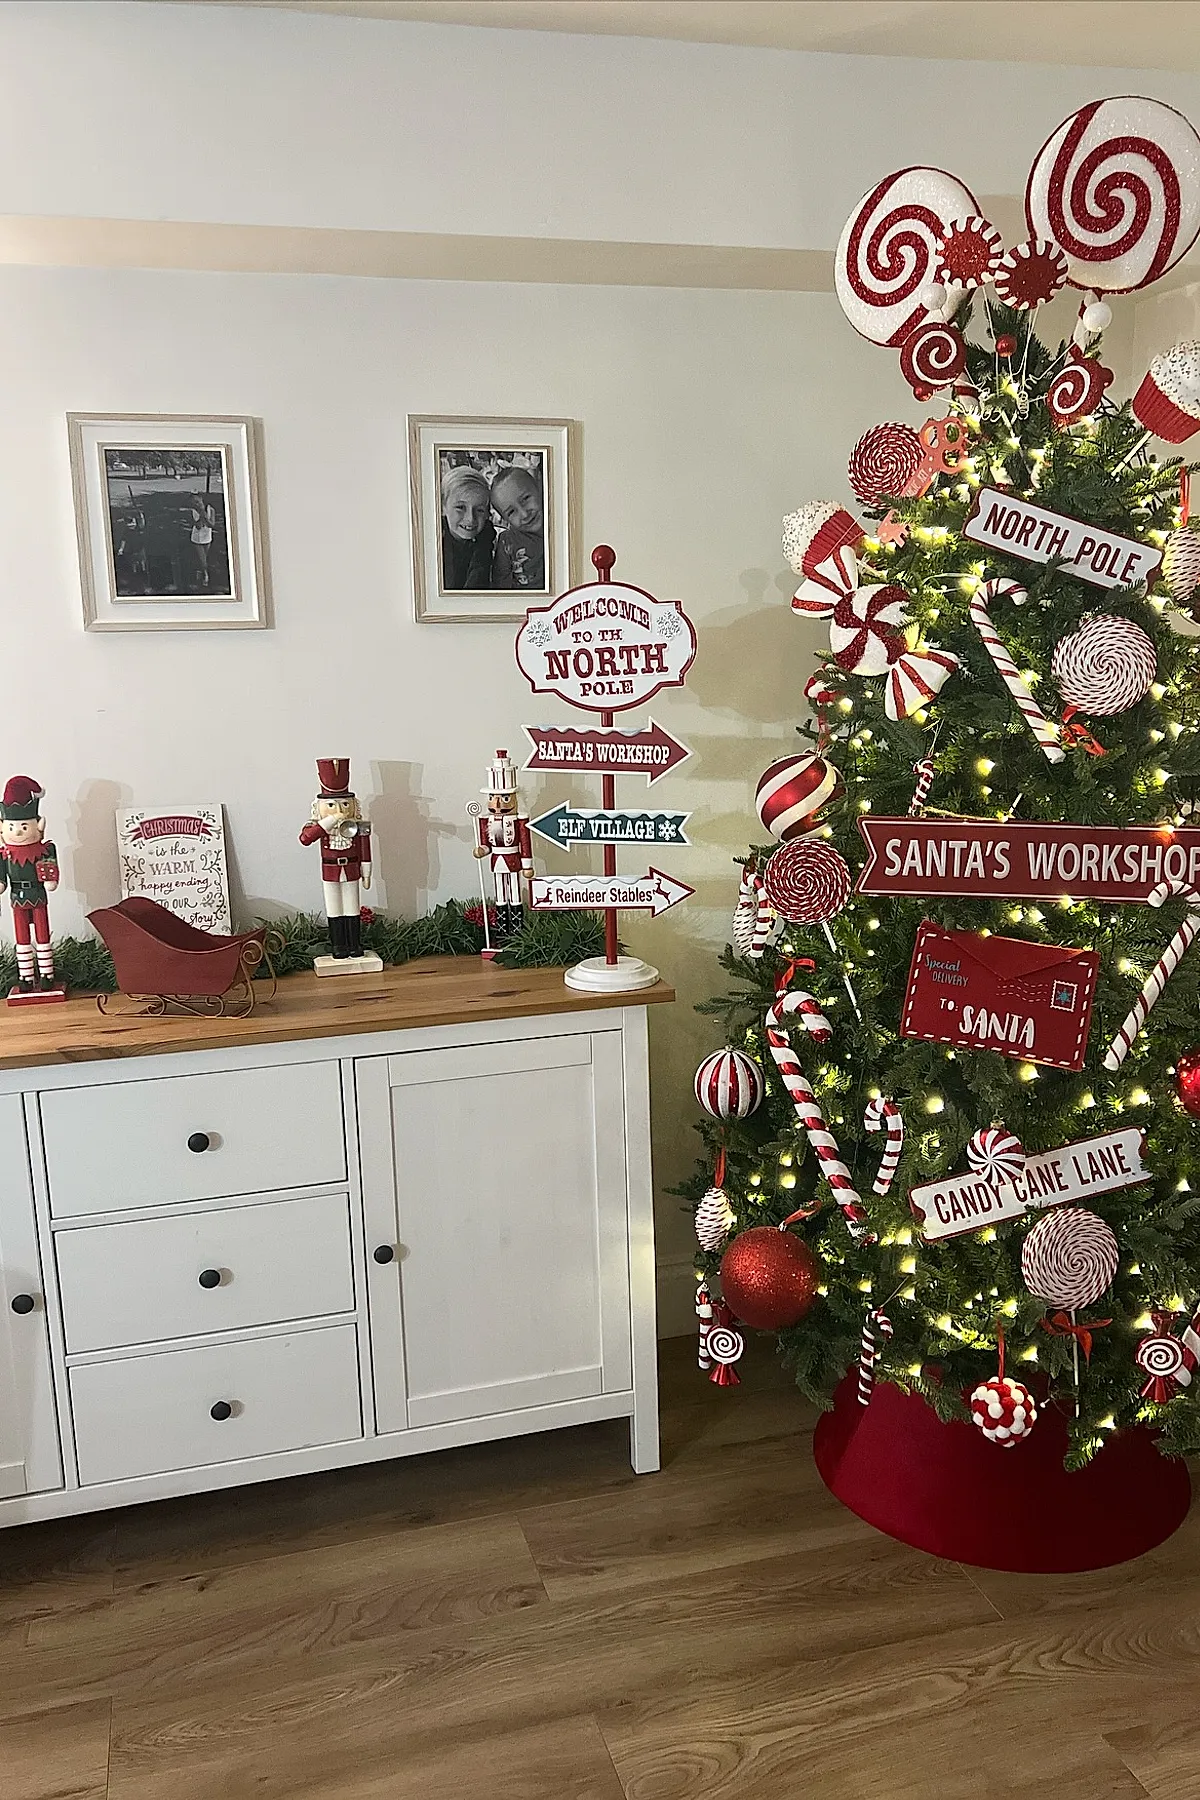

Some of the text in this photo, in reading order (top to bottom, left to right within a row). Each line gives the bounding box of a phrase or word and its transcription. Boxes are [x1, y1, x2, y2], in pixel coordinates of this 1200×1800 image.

[983, 502, 1142, 584] NORTH POLE
[553, 597, 651, 634] WELCOME
[572, 631, 592, 643] TO
[544, 643, 668, 680] NORTH
[580, 680, 634, 696] POLE
[538, 741, 670, 765] SANTA'S WORKSHOP
[557, 818, 655, 839] ELF VILLAGE
[155, 841, 189, 857] is the
[884, 839, 1200, 883] SANTA'S WORKSHOP
[138, 876, 212, 896] happy ending
[556, 887, 652, 904] Reindeer Stables
[924, 954, 961, 971] Special
[932, 971, 969, 988] DELIVERY
[940, 998, 959, 1012] TO:
[959, 1005, 1035, 1048] SANTA
[934, 1143, 1132, 1224] CANDY CANE LANE
